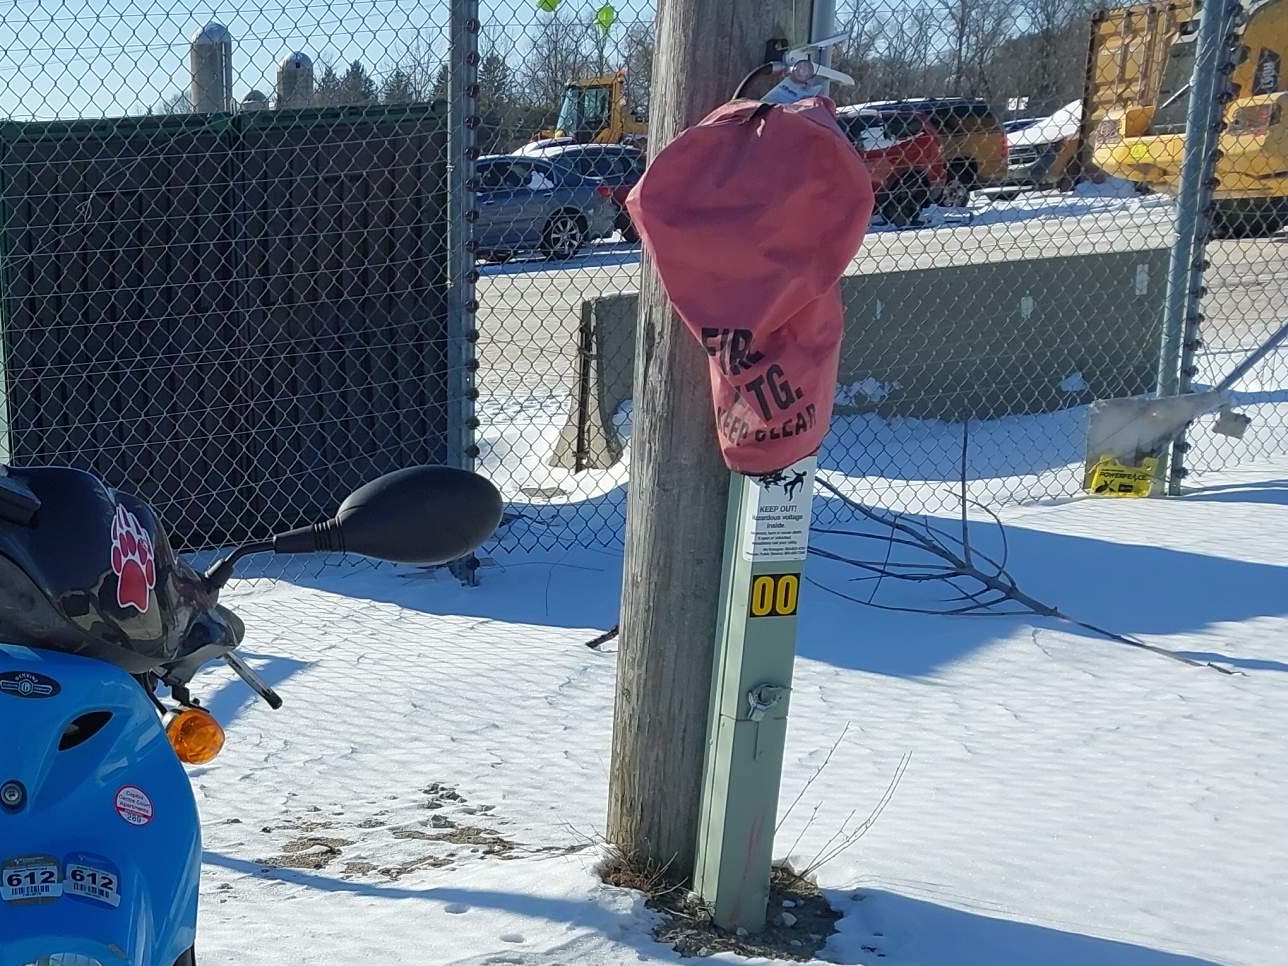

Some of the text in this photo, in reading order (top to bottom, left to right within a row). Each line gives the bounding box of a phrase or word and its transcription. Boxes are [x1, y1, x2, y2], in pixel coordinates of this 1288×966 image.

[760, 505, 780, 513] KEEP
[751, 574, 799, 616] 00
[7, 870, 56, 888] 612
[70, 869, 114, 892] 612
